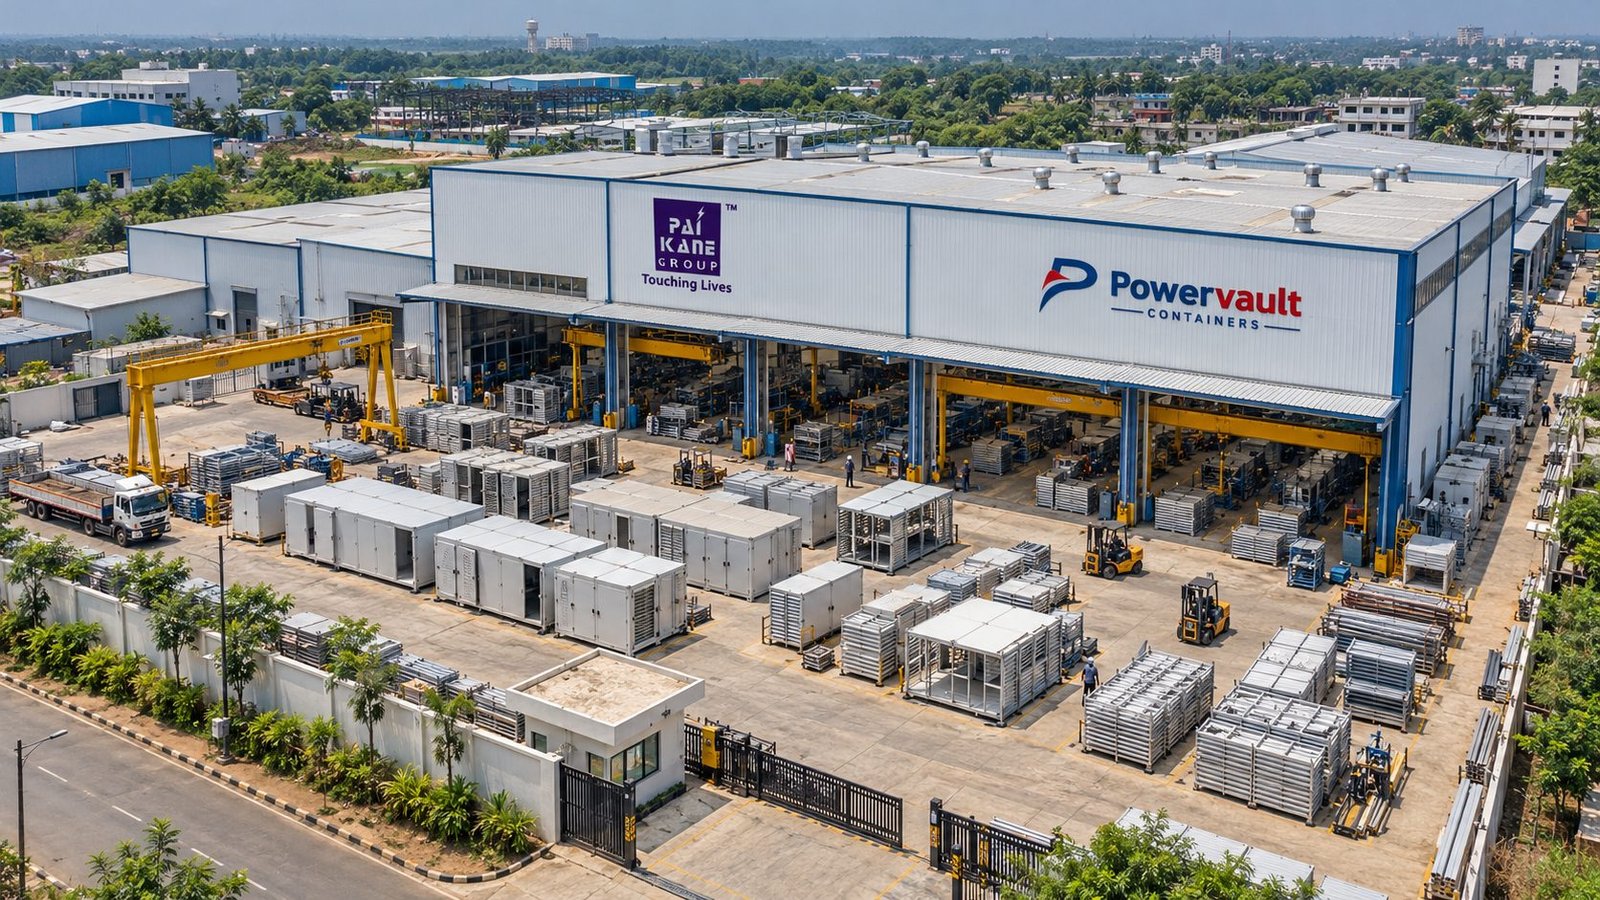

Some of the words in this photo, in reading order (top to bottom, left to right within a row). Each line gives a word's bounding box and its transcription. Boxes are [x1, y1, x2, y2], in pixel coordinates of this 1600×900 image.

[669, 206, 704, 235] PAI
[660, 236, 715, 256] KANE
[658, 258, 718, 271] GROUP
[641, 273, 697, 292] Touching
[701, 280, 732, 293] Lives
[1111, 271, 1302, 317] Powervault
[1147, 308, 1259, 330] CONTAINERS
